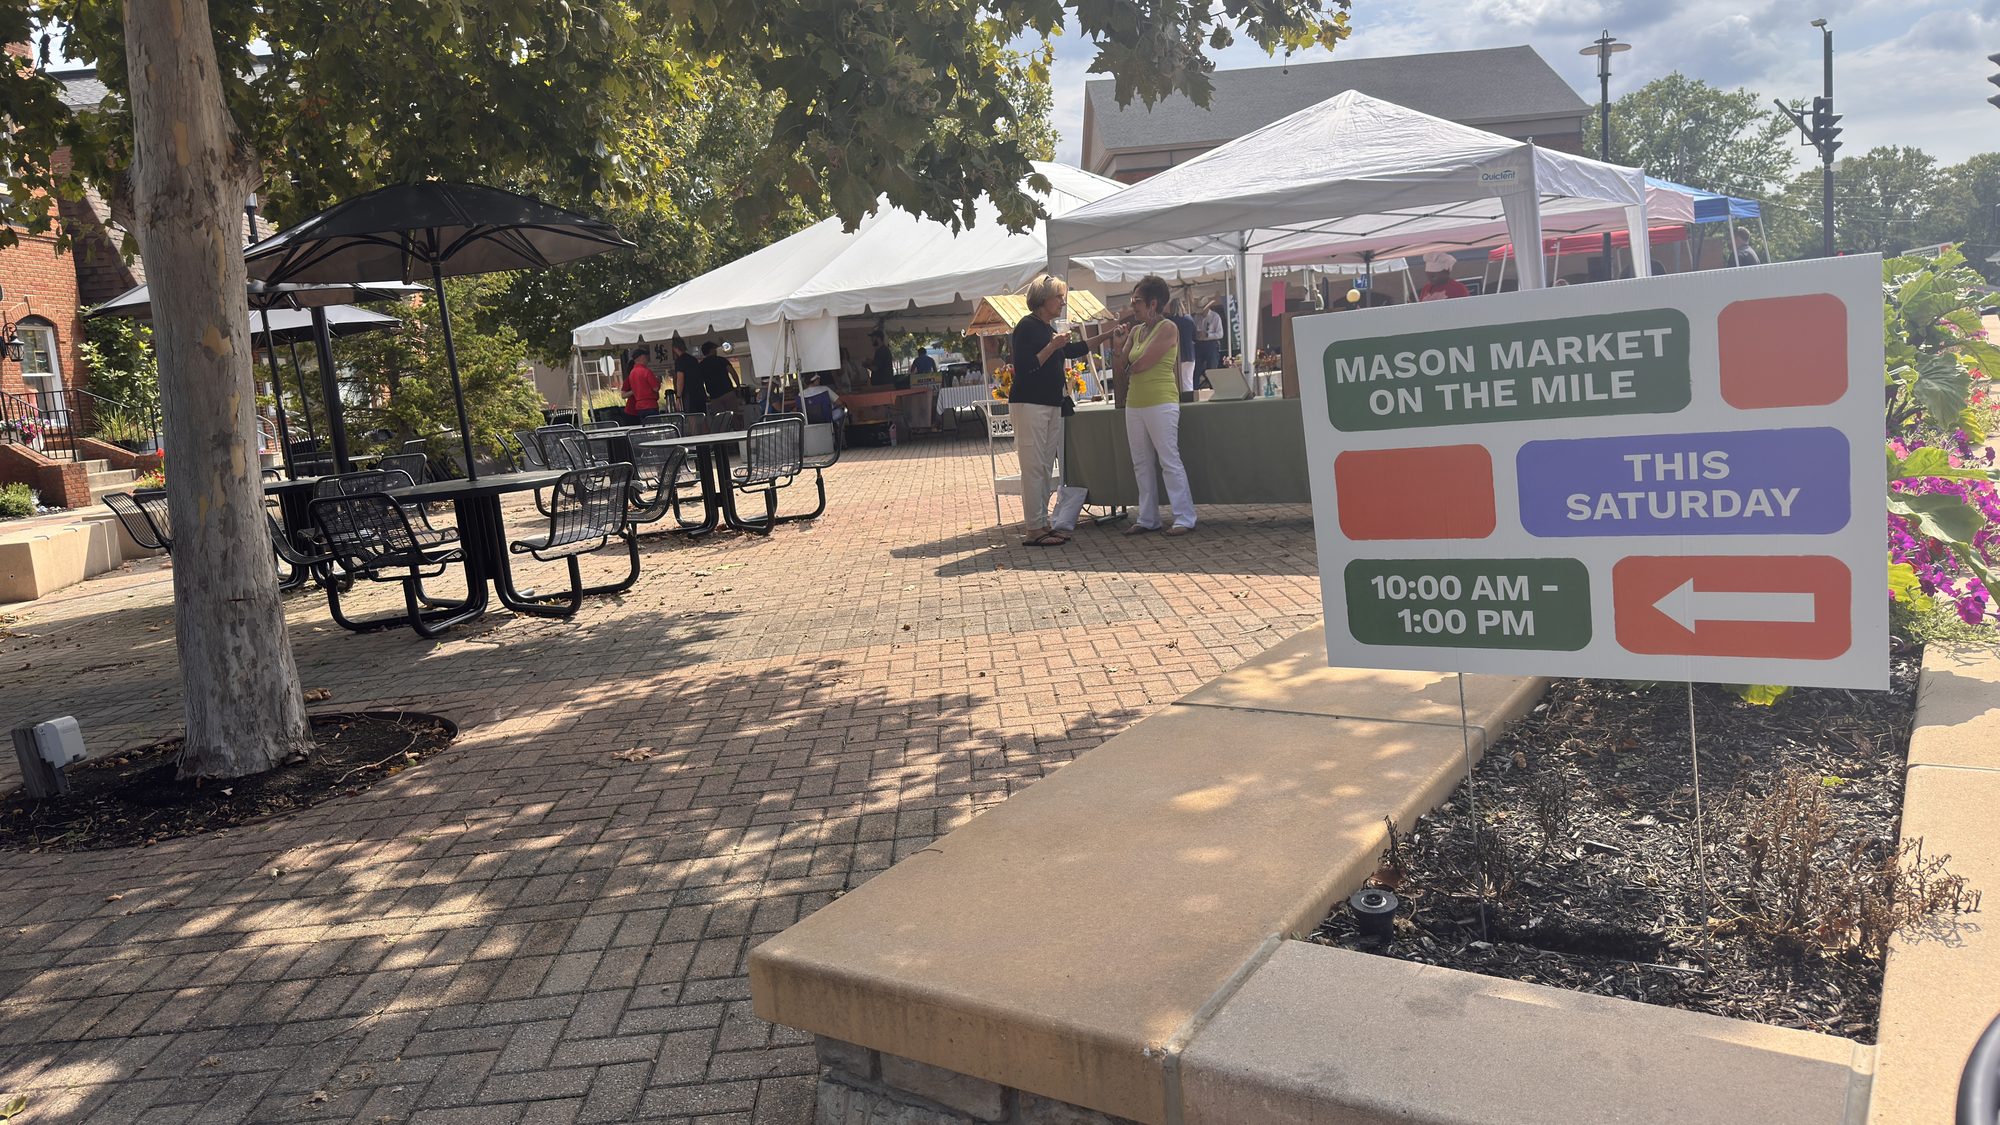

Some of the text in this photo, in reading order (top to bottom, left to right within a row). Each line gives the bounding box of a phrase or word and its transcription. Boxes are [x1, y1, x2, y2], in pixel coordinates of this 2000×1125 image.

[1336, 328, 1672, 384] MASON MARKET
[1370, 370, 1636, 415] ON THE MILE
[1624, 451, 1729, 481] THIS
[1567, 488, 1800, 520] SATURDAY
[1371, 575, 1461, 600] 10:00
[1471, 576, 1529, 600] AM
[1398, 609, 1534, 635] 1:00 PM
